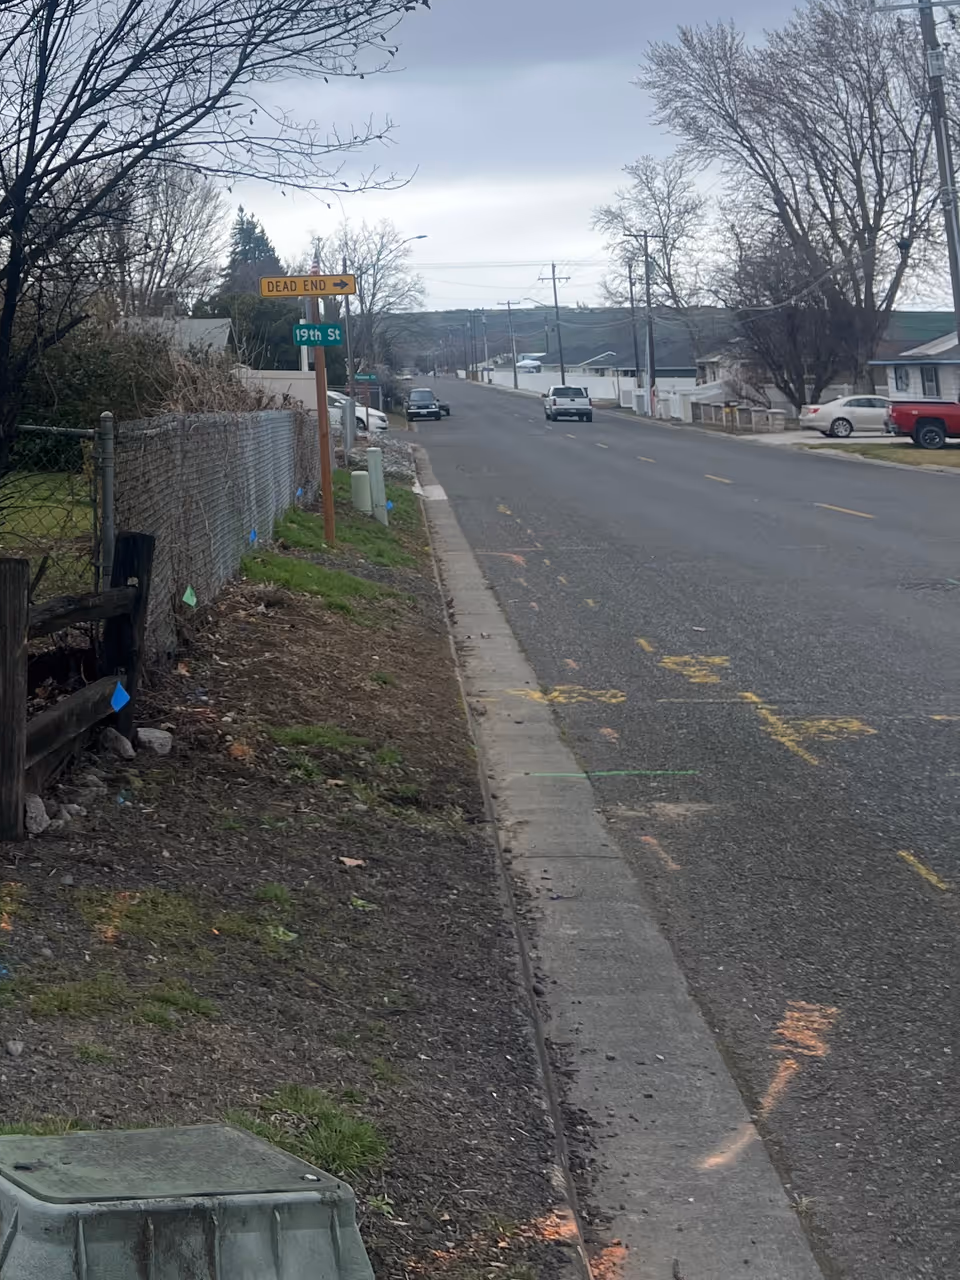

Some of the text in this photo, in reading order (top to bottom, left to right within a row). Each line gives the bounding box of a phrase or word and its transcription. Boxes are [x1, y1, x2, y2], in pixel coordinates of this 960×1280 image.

[267, 280, 326, 293] DEAD END
[295, 328, 340, 341] 19th St
